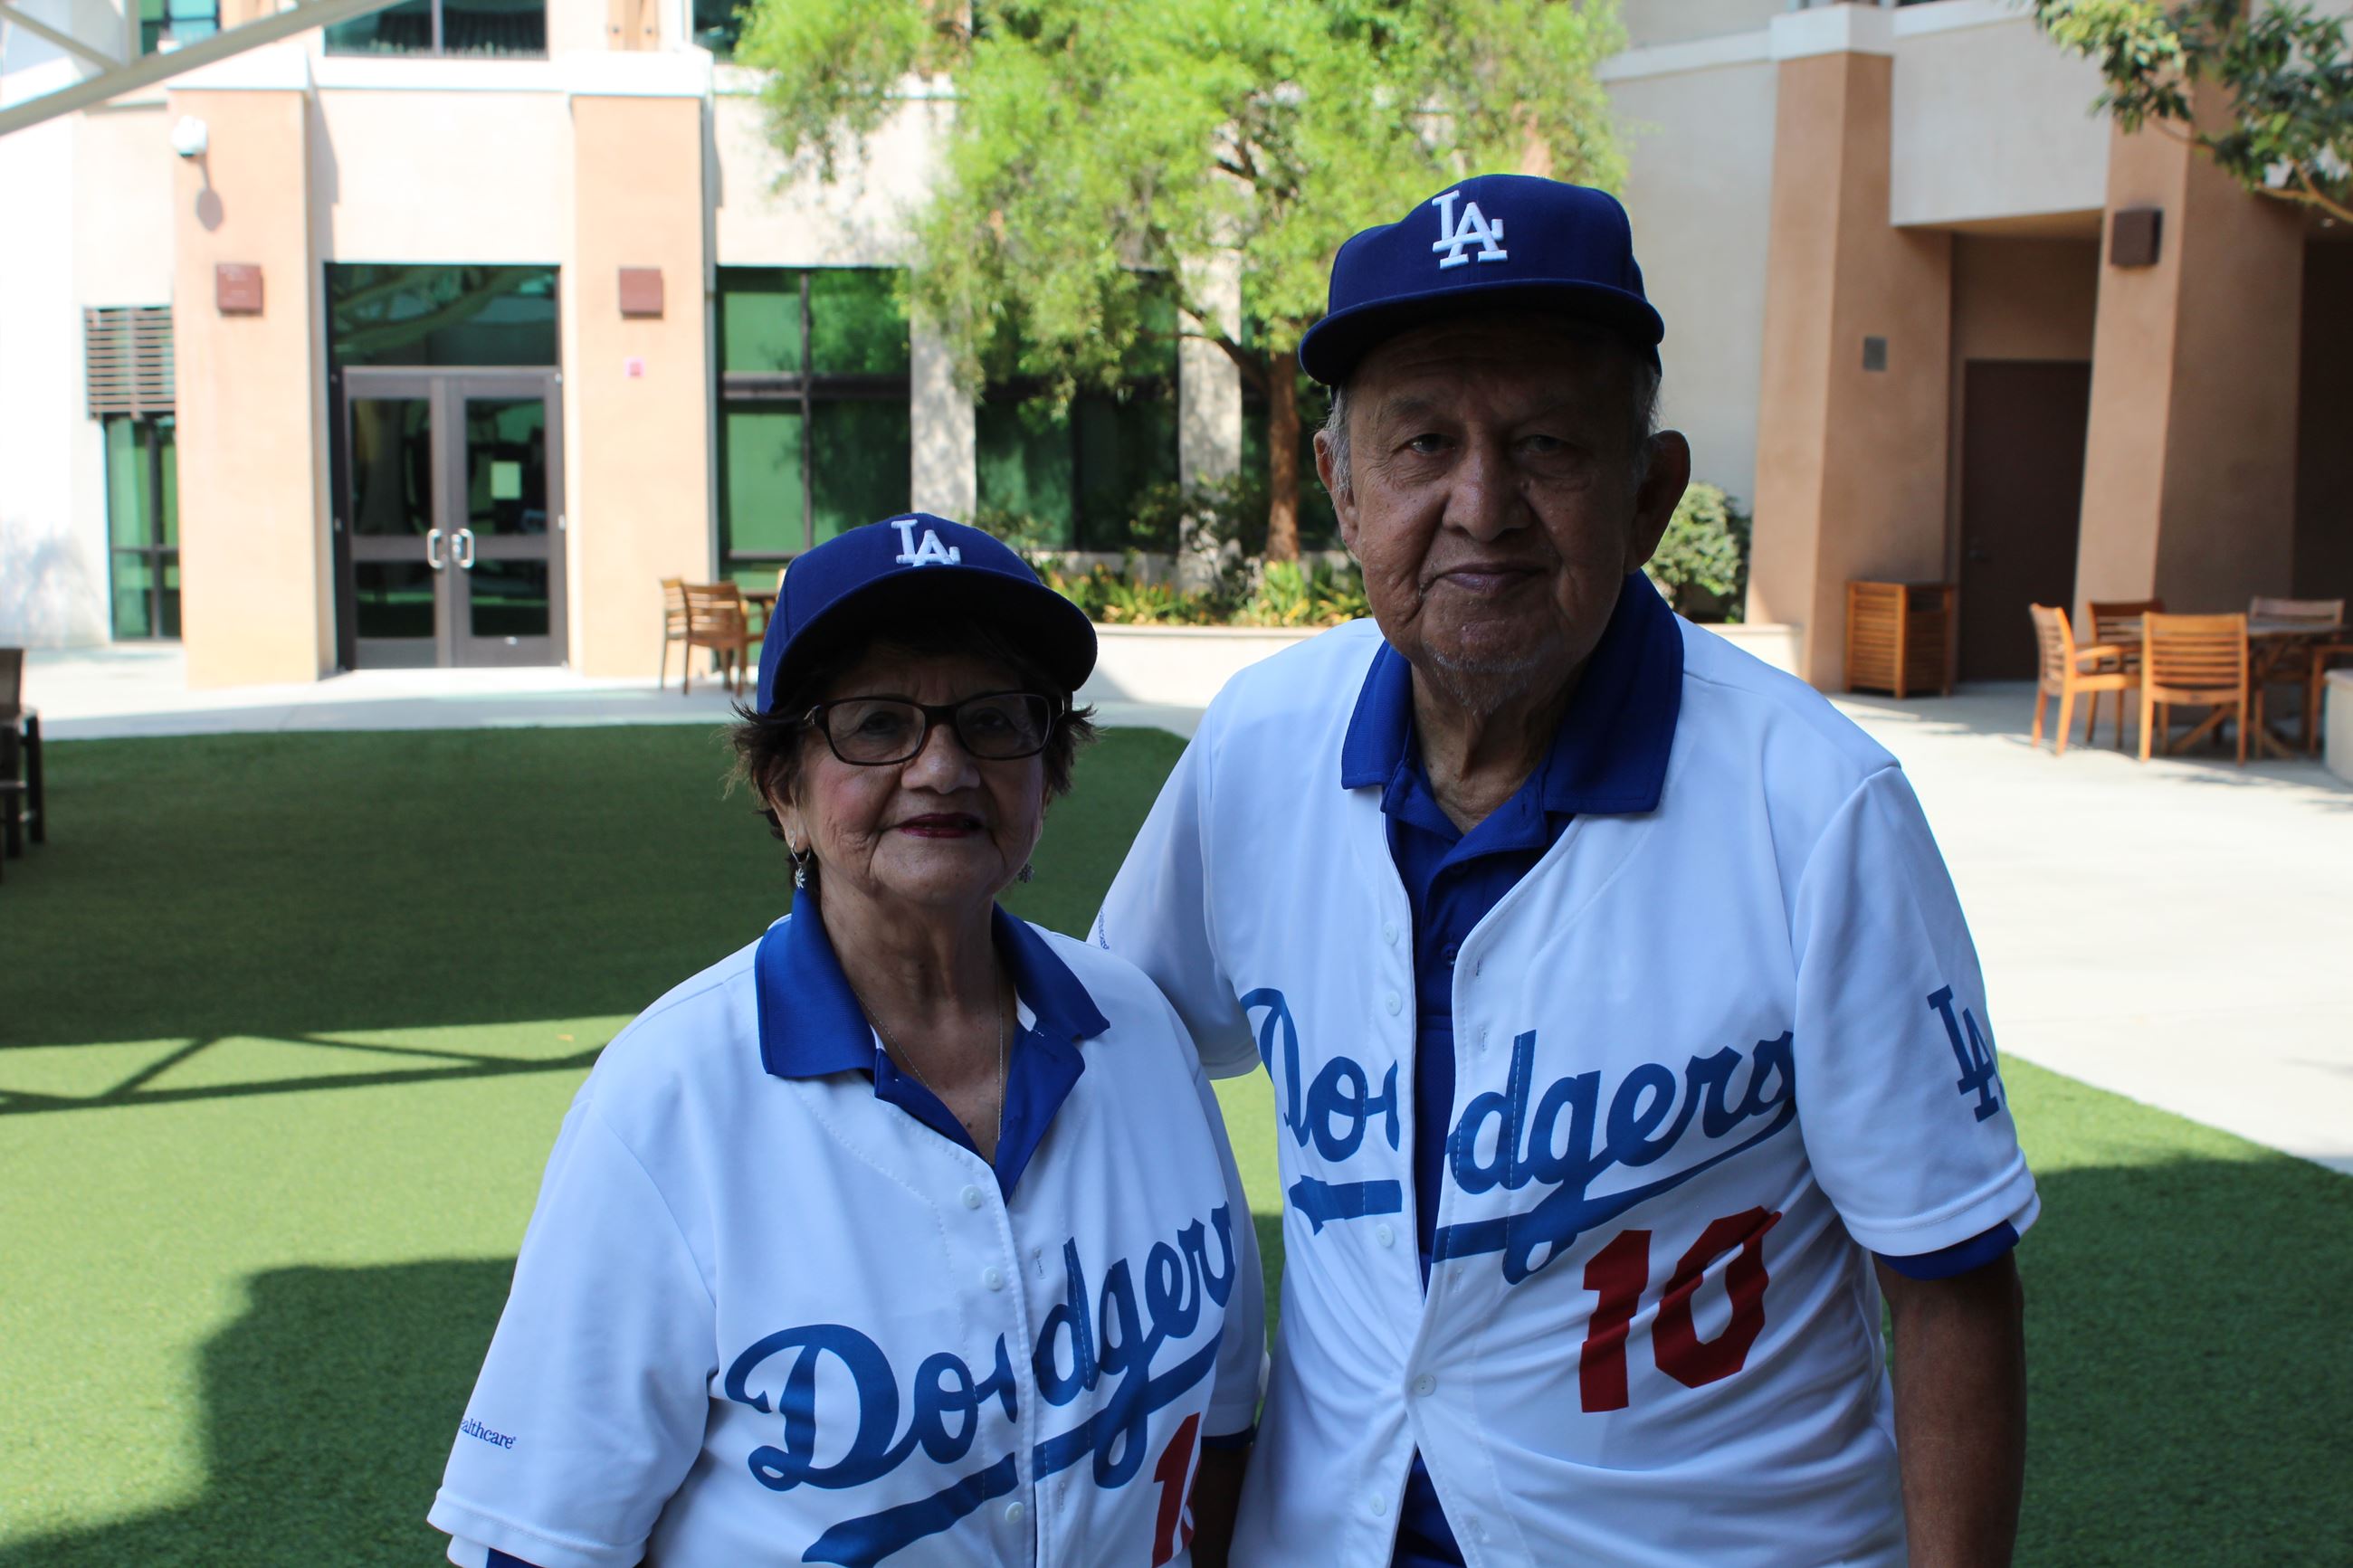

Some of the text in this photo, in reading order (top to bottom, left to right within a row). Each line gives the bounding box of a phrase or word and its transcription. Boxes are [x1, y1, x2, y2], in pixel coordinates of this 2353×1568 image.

[1432, 190, 1508, 270] LA
[891, 518, 961, 566] LA
[1579, 1205, 1783, 1413] 10
[459, 1418, 516, 1449] althcare
[1151, 1411, 1202, 1568] 1
